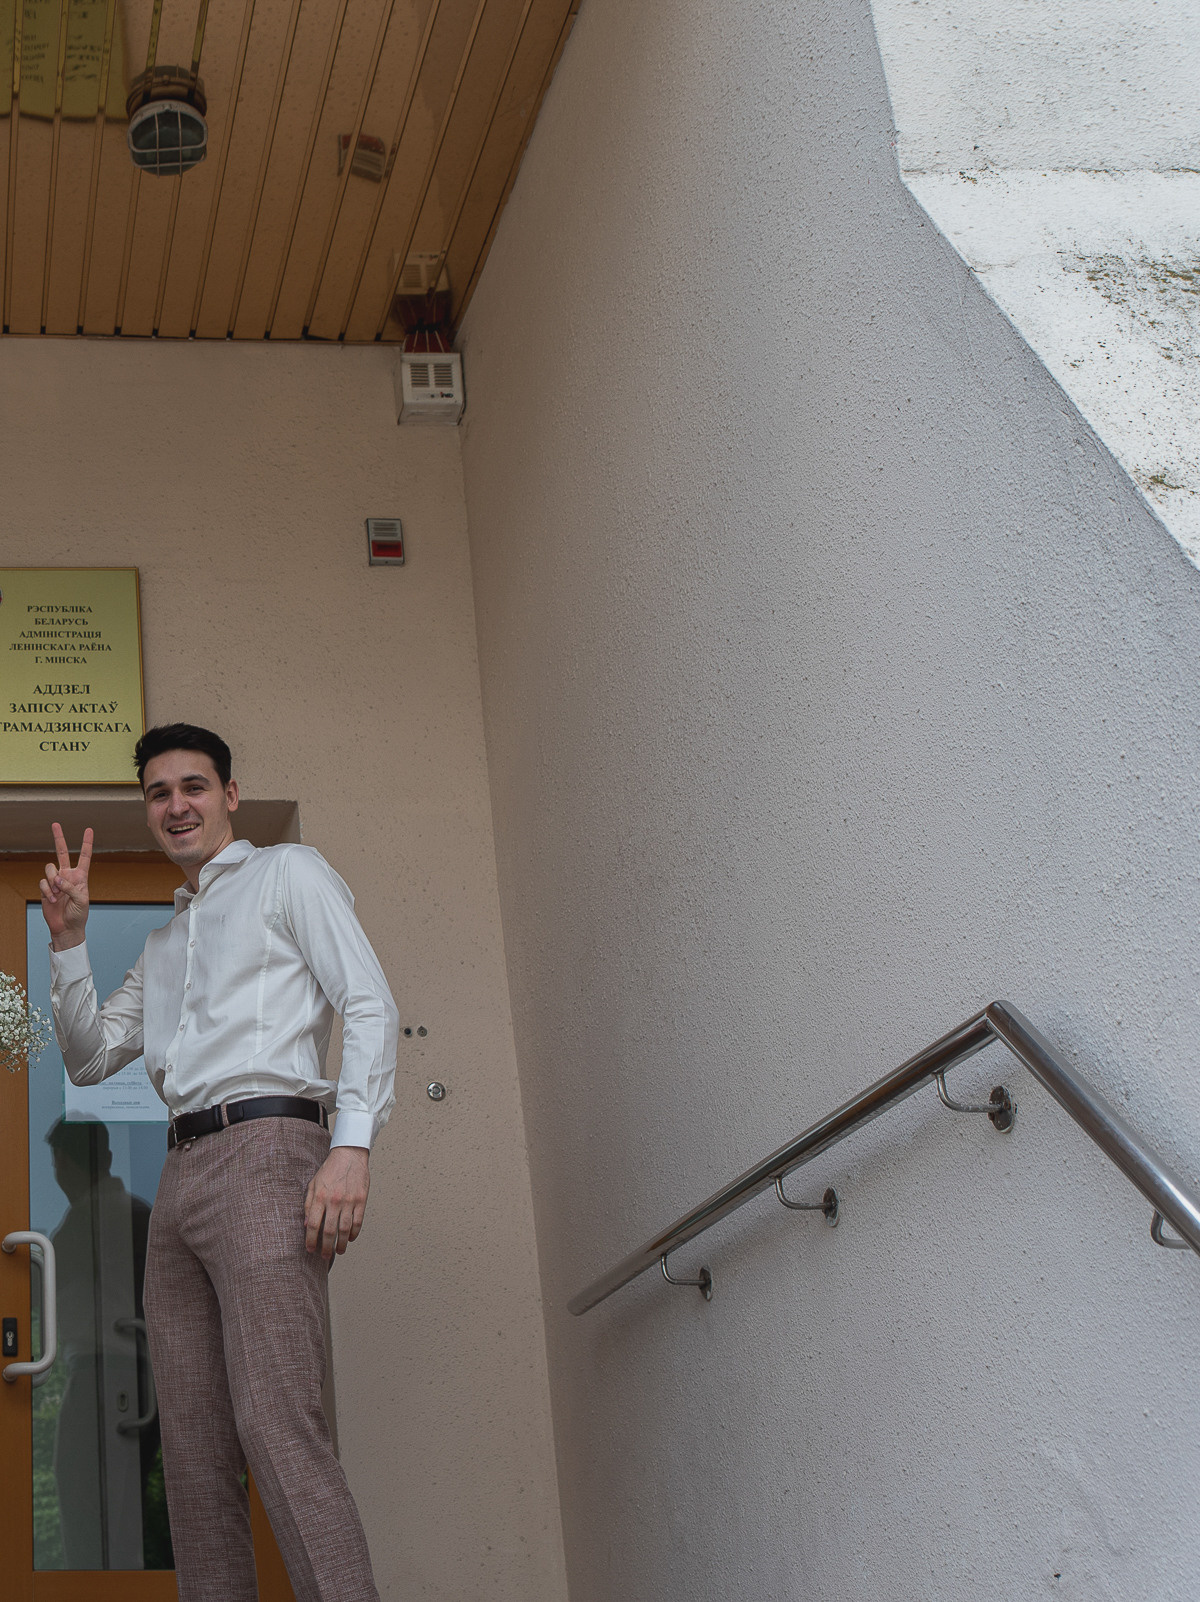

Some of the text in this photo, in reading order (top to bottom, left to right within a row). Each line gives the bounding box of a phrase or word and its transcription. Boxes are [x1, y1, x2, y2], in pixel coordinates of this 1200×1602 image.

[27, 605, 93, 613] РЭСПУБЛІКА
[34, 618, 89, 626] БЕЛАРУСЬ
[19, 630, 102, 639] АДМІНІСТРАЦІЯ
[9, 642, 112, 651] ЛЕНІНСКАГА РАЁНА
[35, 656, 87, 664] Г. МІНСКА
[33, 684, 91, 696] АДДЗЕЛ
[9, 700, 118, 714] ЗАПІСУ АКТАЎ
[39, 741, 91, 752] СТАНУ
